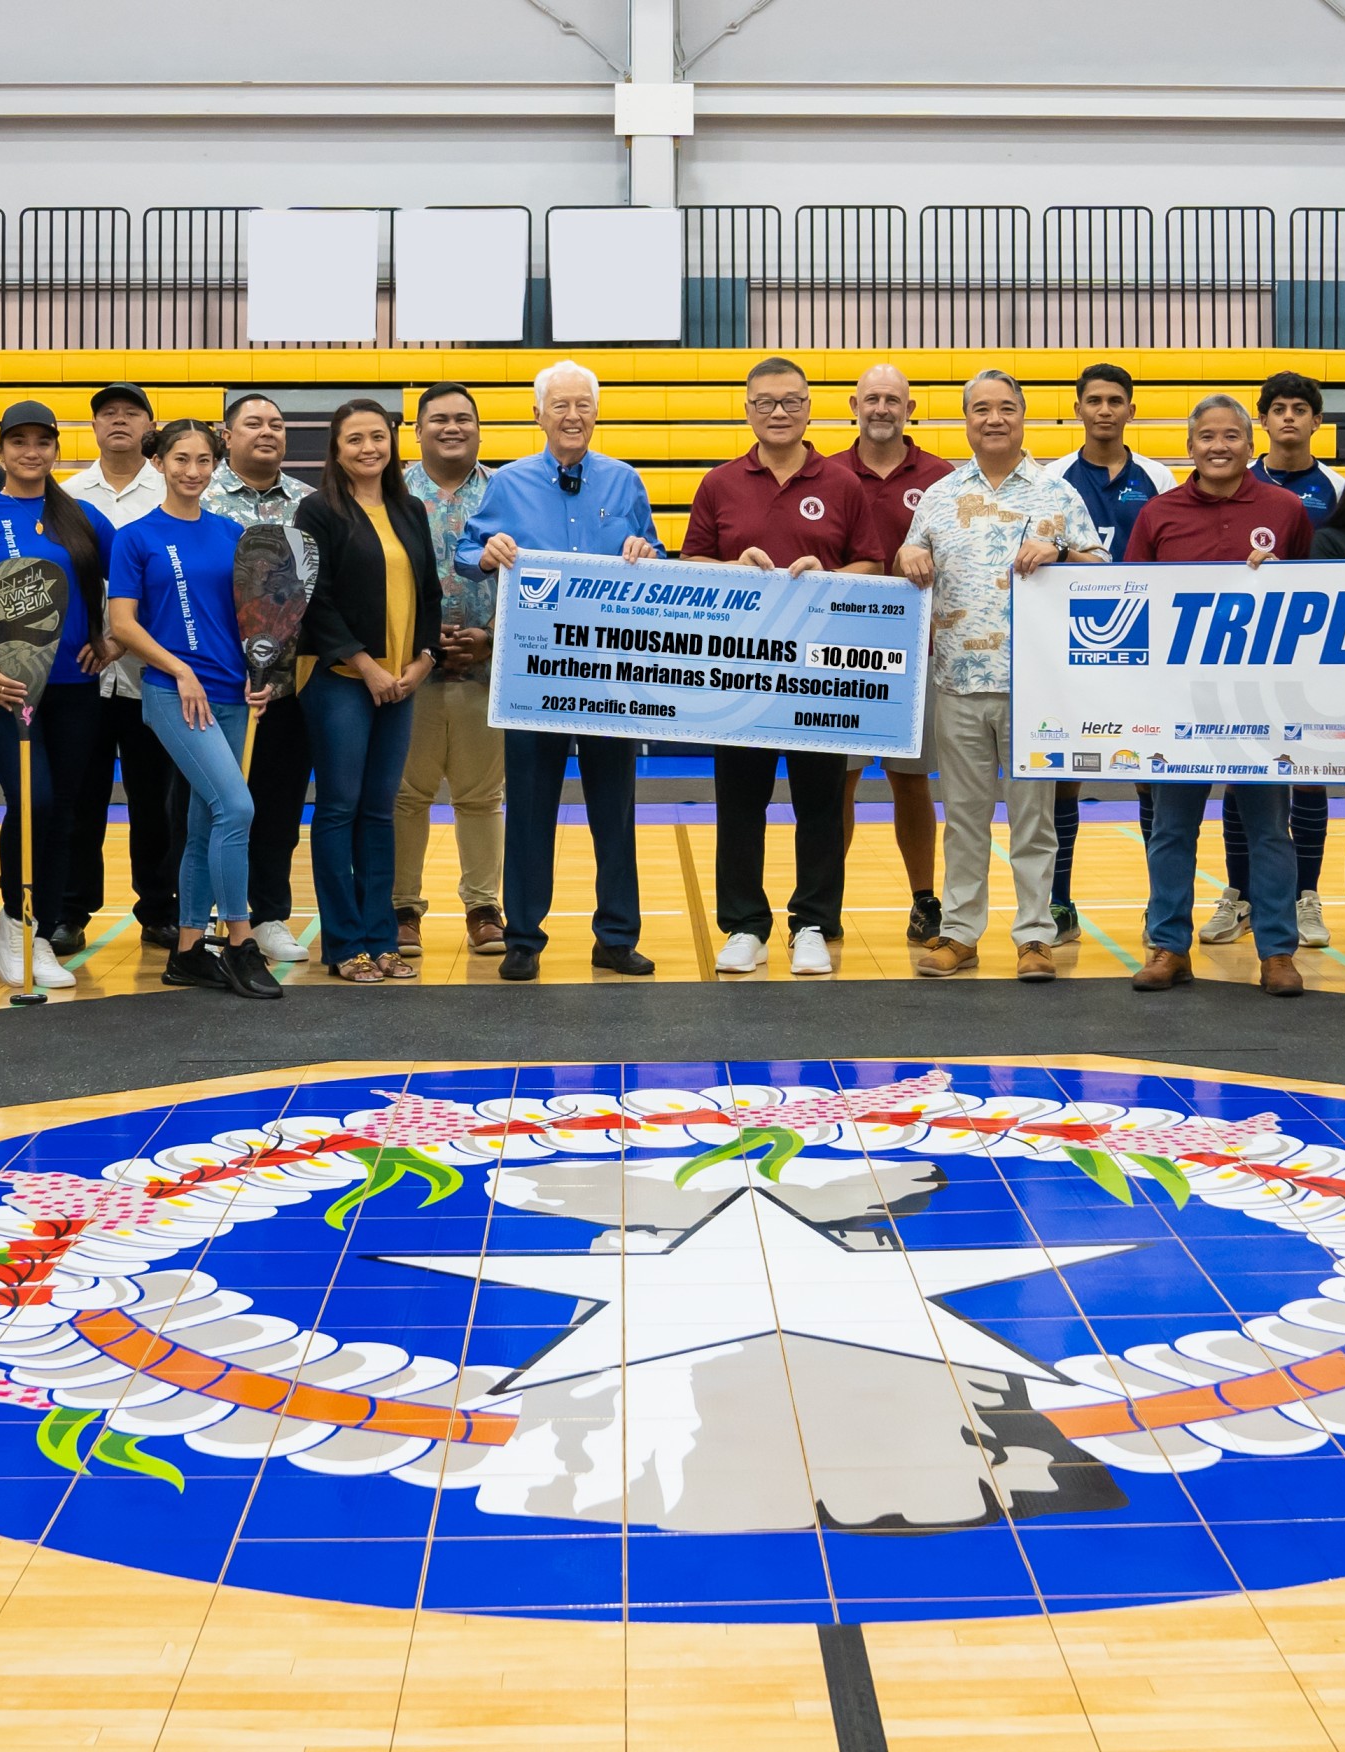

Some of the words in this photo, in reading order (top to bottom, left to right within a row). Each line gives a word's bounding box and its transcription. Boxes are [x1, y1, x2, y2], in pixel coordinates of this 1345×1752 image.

[1069, 581, 1121, 592] Customers
[1124, 581, 1148, 592] First
[166, 544, 184, 579] Northern
[176, 579, 191, 618] Mariana
[184, 618, 198, 651] Islands
[565, 577, 629, 601] TRIPLE
[630, 583, 645, 602] J
[645, 583, 719, 609] SAIPAN,
[722, 589, 762, 612] INC.
[4, 591, 51, 619] VIPER
[519, 602, 548, 610] TRIPLE
[808, 606, 825, 614] Date
[830, 601, 867, 614] October
[868, 604, 880, 615] 13,
[881, 604, 905, 615] 2023
[600, 604, 614, 613] P.O.
[616, 605, 630, 614] Box
[631, 606, 662, 618] 500487,
[663, 609, 692, 620] Saipan,
[693, 611, 705, 620] MP
[706, 611, 730, 621] 96950
[513, 633, 526, 643] Pay
[527, 634, 535, 642] to
[536, 634, 549, 642] the
[553, 623, 589, 648] TEN
[594, 626, 703, 656] THOUSAND
[707, 635, 798, 663] DOLLARS
[540, 642, 548, 650] of
[1071, 652, 1130, 664] TRIPLE
[1136, 652, 1147, 664] J
[527, 654, 612, 680] Northern
[615, 661, 705, 687] Marianas
[709, 667, 772, 692] Sports
[775, 673, 889, 700] Association
[509, 702, 533, 711] Memo
[541, 695, 576, 711] 2023
[579, 697, 626, 715] Pacific
[629, 700, 676, 717] Games
[794, 711, 860, 729] DONATION
[1081, 721, 1123, 734] Hertz
[1194, 724, 1224, 735] TRIPLE
[1225, 725, 1231, 735] J
[1231, 725, 1270, 735] MOTORS
[1167, 764, 1214, 774] WHOLESALE
[1215, 765, 1225, 774] TO
[1227, 765, 1269, 775] EVERYONE
